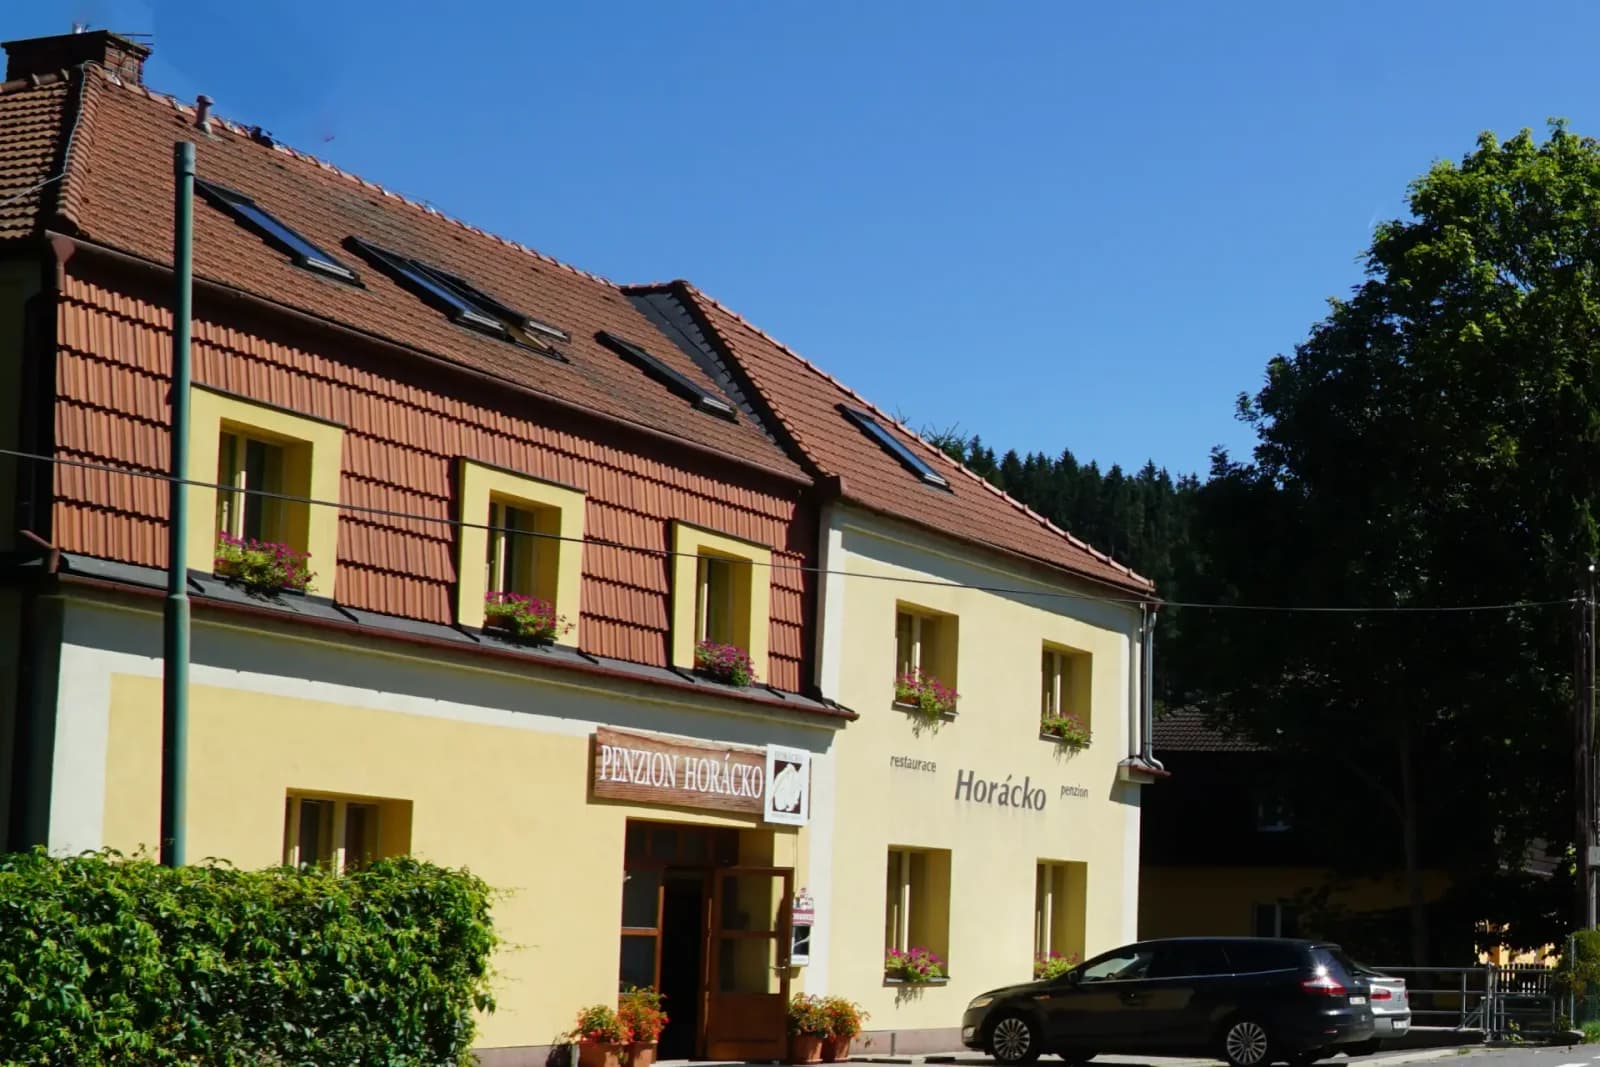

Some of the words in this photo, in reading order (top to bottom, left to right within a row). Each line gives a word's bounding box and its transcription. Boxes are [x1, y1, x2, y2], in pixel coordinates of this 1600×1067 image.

[600, 745, 677, 788] PENZION
[683, 753, 763, 799] HORÁCKO
[890, 755, 936, 772] restaurace
[954, 769, 1046, 811] Horácko
[1060, 784, 1088, 799] penzion
